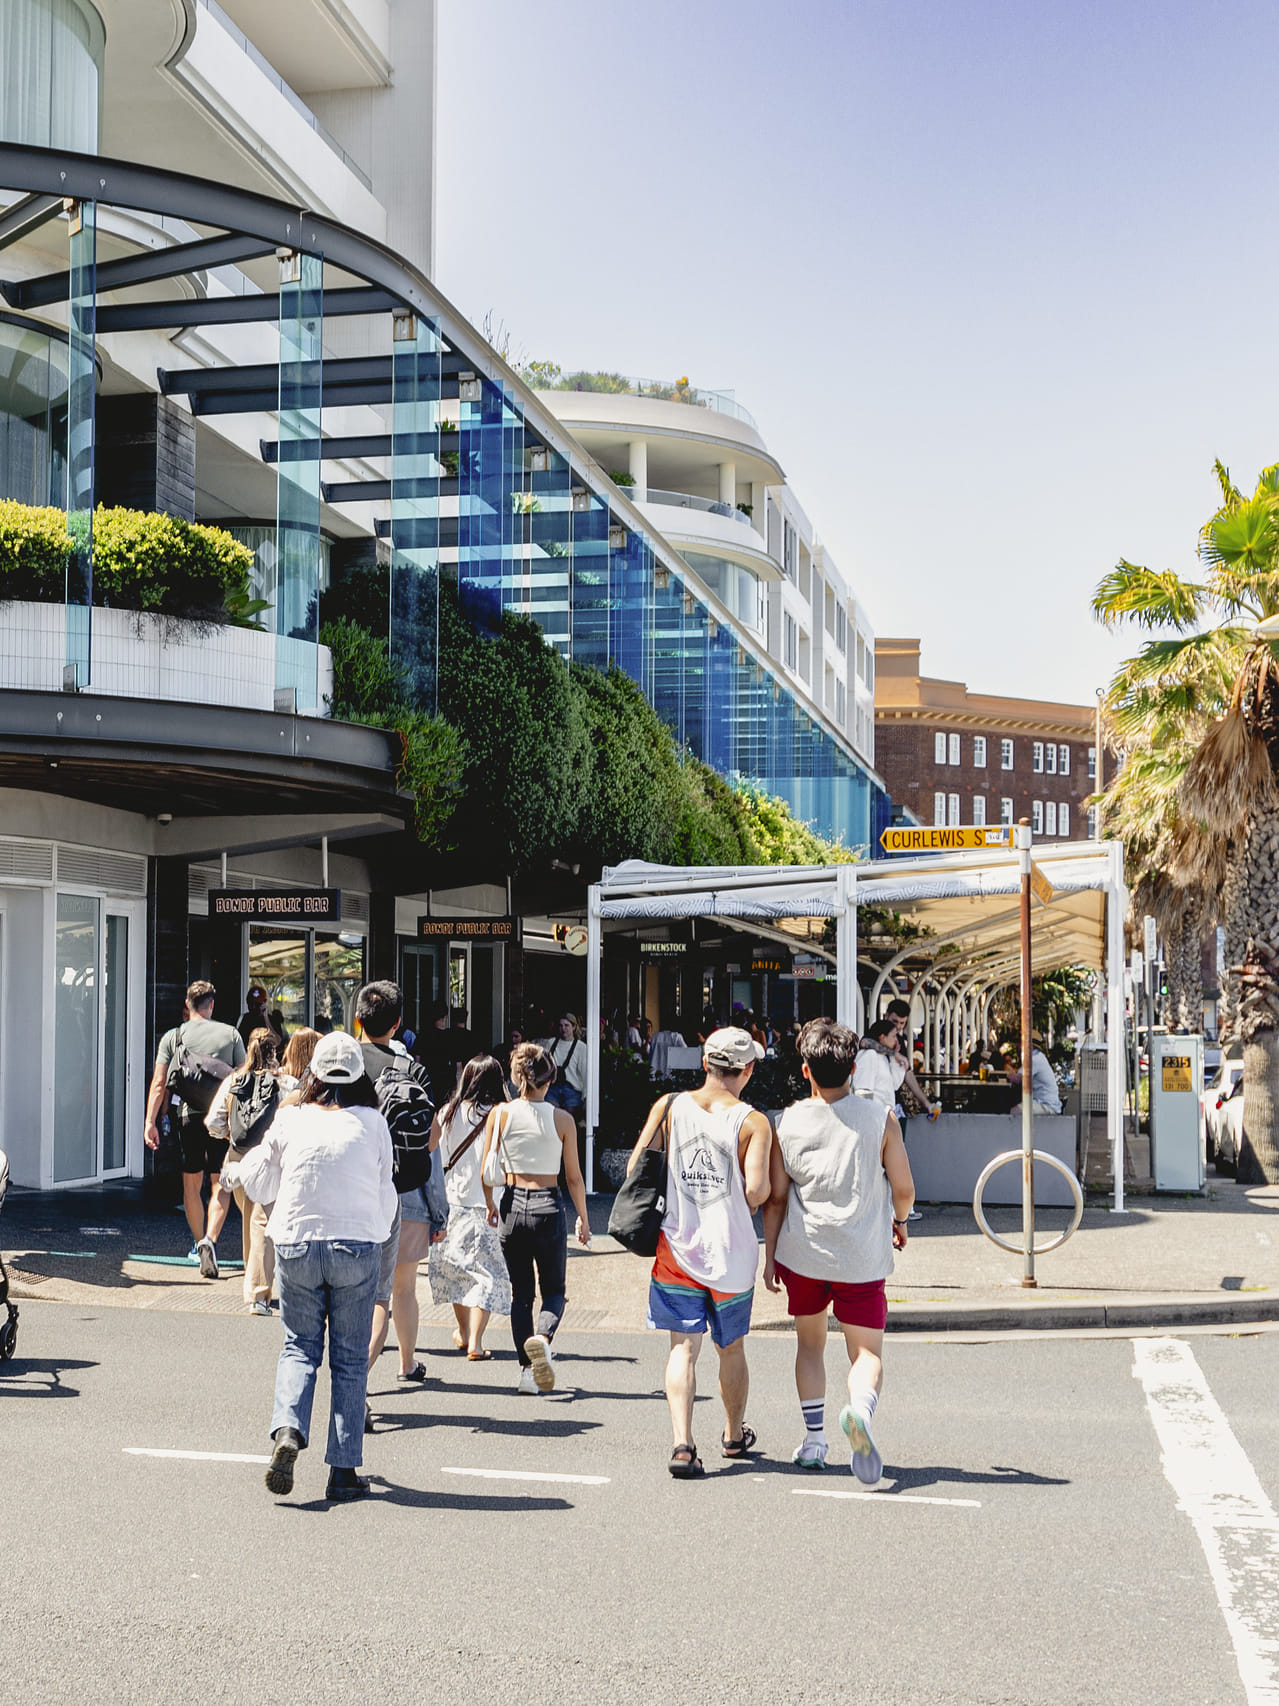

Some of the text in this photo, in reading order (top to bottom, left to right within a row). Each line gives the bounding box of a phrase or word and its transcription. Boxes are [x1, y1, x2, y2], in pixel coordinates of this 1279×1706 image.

[892, 829, 965, 848] CURLEWIS
[216, 897, 329, 913] BONDI PUBLIC BAR
[423, 922, 512, 935] BONDI PUBLIC BAR
[640, 943, 687, 952] BIRKENSTOCK
[1164, 1056, 1189, 1068] 2315
